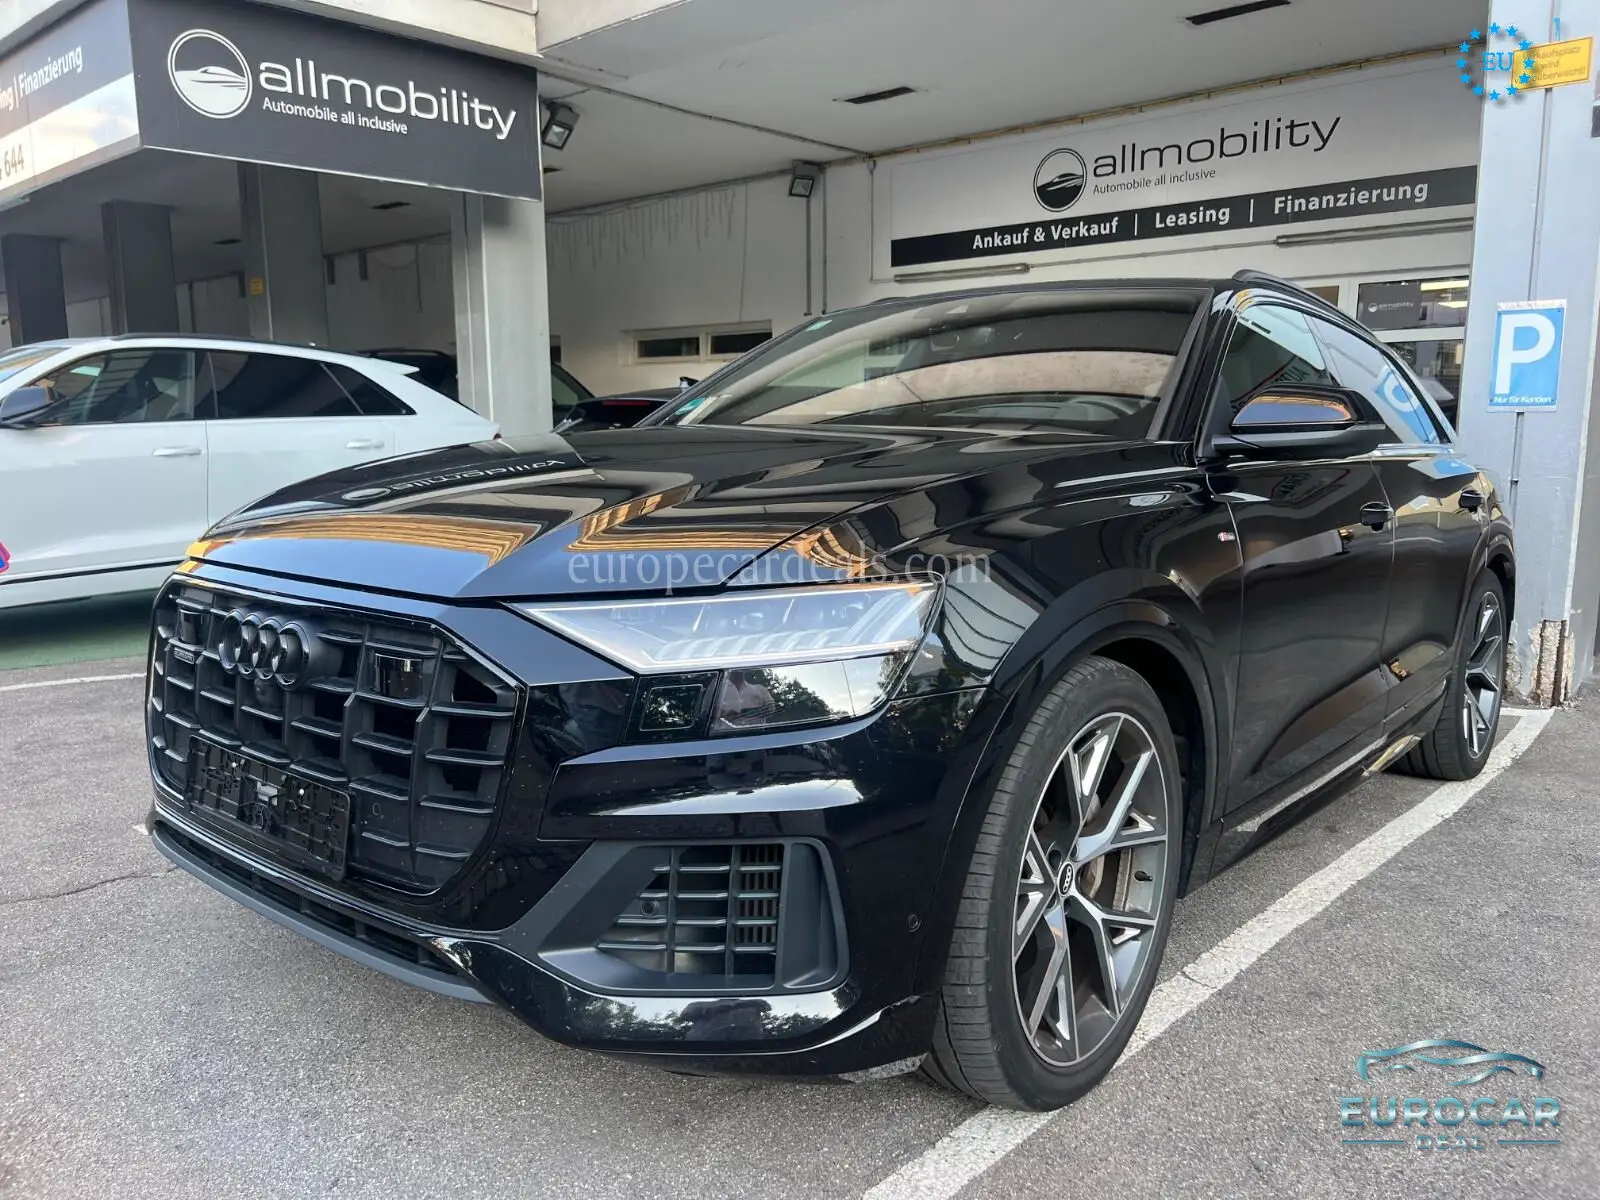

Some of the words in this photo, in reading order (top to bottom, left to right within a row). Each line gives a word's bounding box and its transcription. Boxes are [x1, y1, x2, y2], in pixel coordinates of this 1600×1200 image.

[18, 45, 83, 98] Finanzierung
[259, 58, 516, 140] allmobility
[263, 97, 338, 122] Automobile
[341, 111, 355, 125] all
[358, 113, 408, 135] inclusive
[4, 144, 25, 178] 644
[1093, 117, 1341, 178] allmobility
[1093, 178, 1152, 195] Automobile
[1154, 174, 1166, 186] all
[1169, 169, 1216, 184] inclusive
[972, 228, 1030, 250] Ankauf
[1033, 227, 1046, 242] &
[1050, 217, 1119, 240] Verkauf
[1155, 206, 1230, 229] Leasing
[1274, 183, 1429, 215] Finanzierung
[1495, 313, 1556, 395] P
